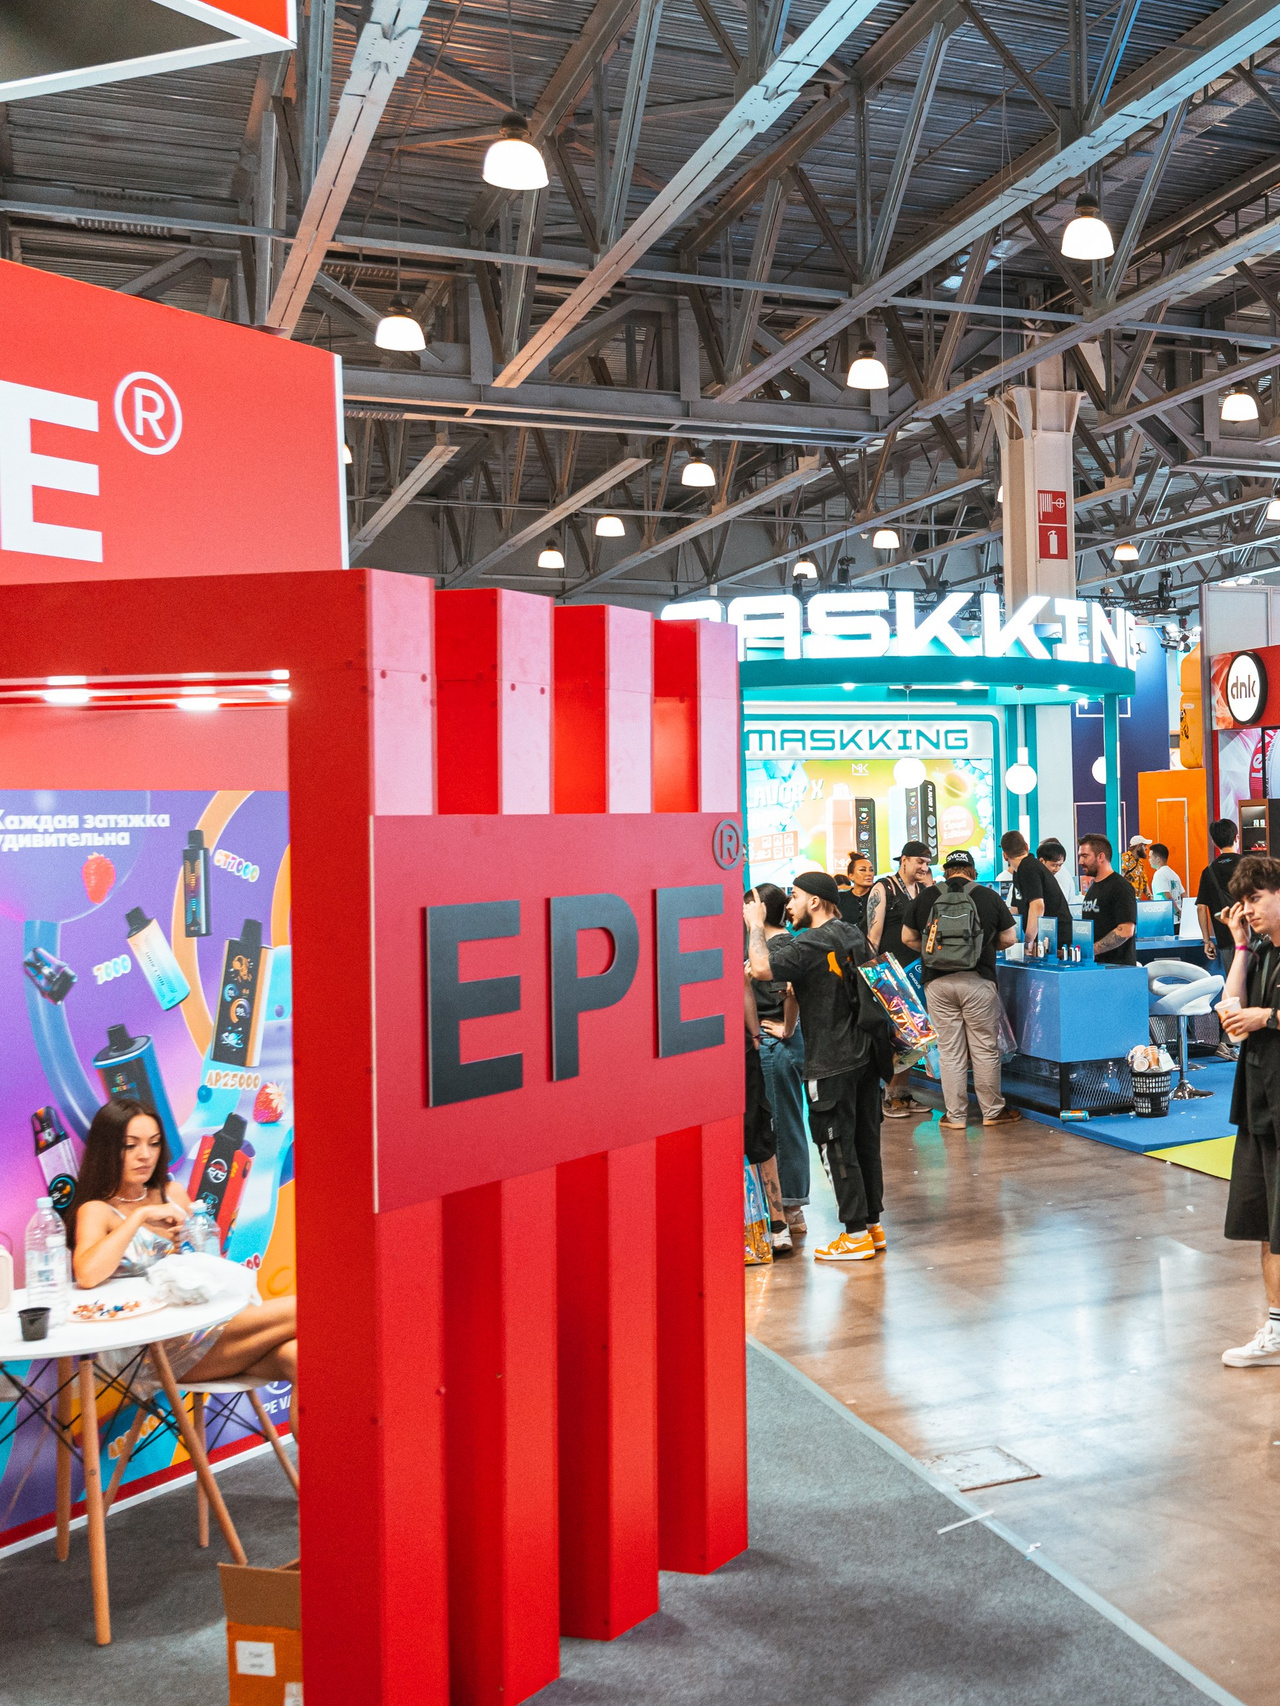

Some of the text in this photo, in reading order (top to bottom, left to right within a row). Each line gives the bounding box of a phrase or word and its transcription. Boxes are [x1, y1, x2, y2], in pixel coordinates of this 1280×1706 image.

[1230, 674, 1257, 701] dnk
[745, 728, 969, 752] MASKKING
[0, 808, 170, 832] аждая затяжка
[946, 853, 968, 861] SMOK
[423, 884, 725, 1108] EPE
